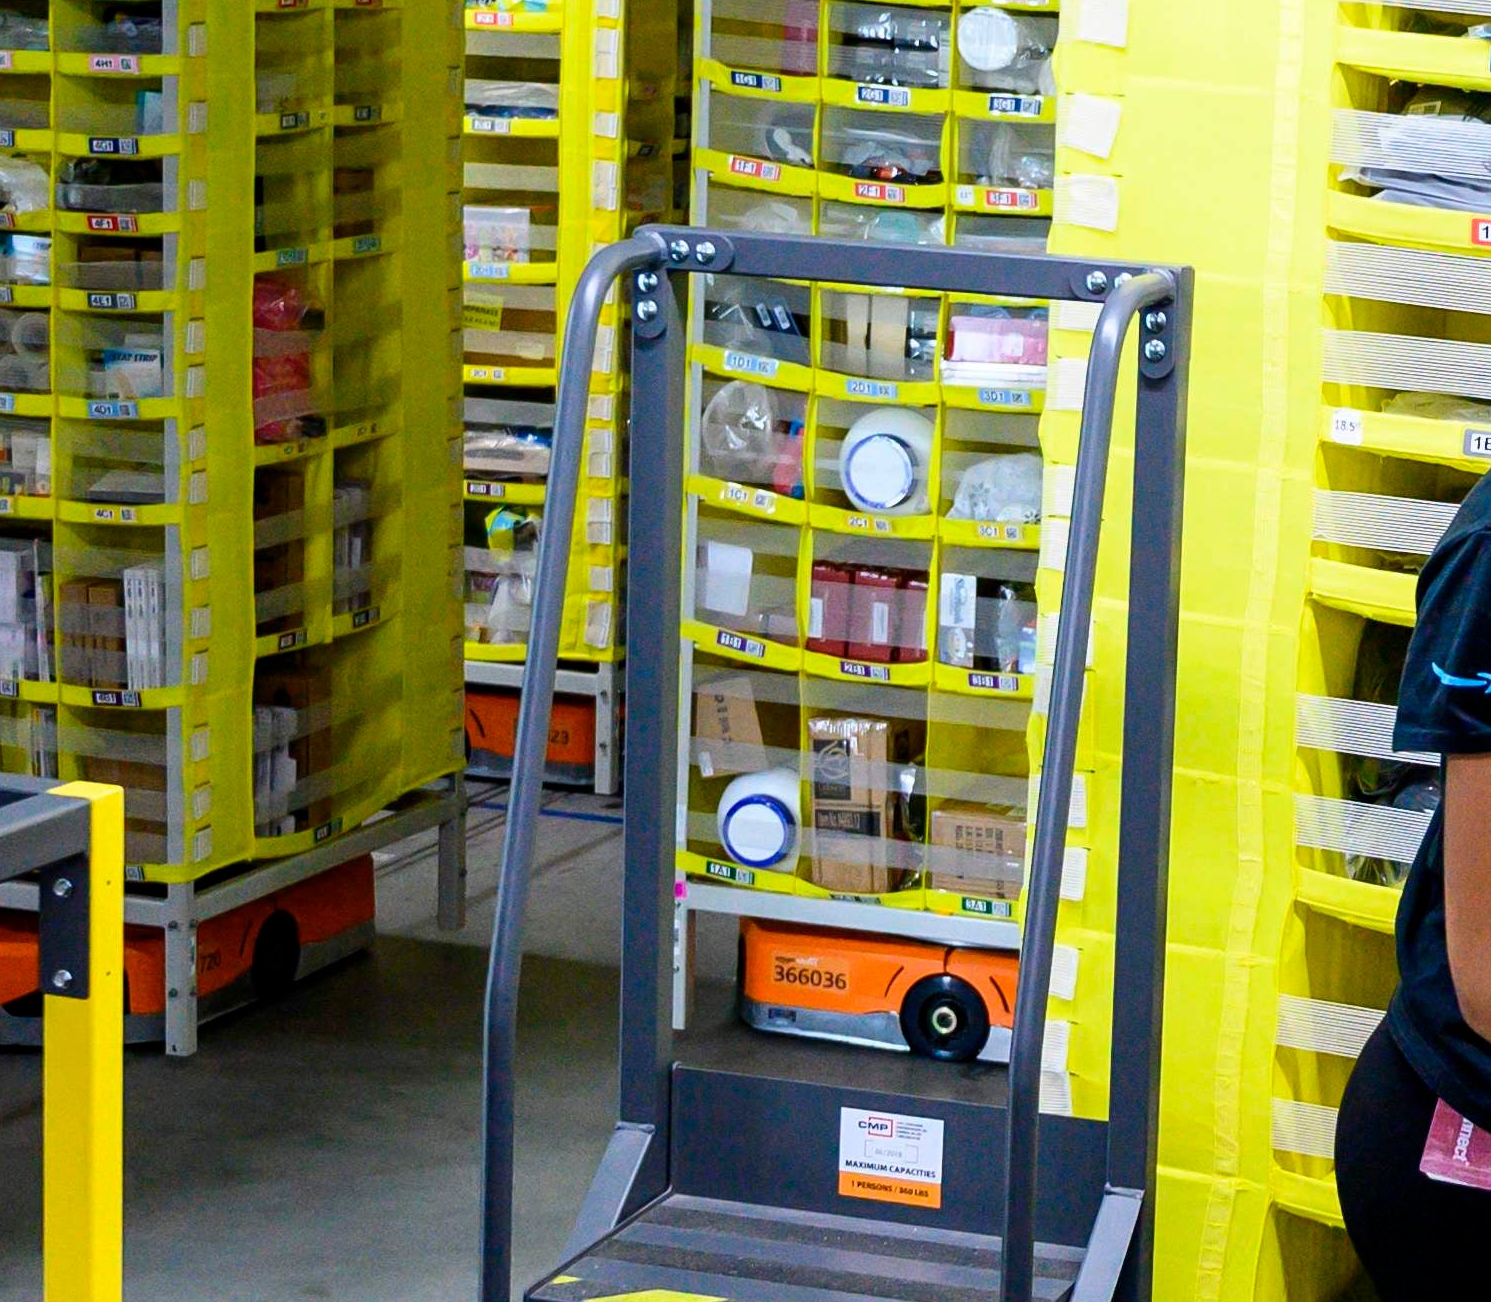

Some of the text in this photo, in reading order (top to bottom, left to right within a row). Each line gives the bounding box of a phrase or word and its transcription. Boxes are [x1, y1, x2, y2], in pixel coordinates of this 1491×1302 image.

[773, 964, 848, 991] 366036
[858, 1120, 889, 1133] CMP
[844, 1159, 936, 1180] MAXIMUM CAPACITIES
